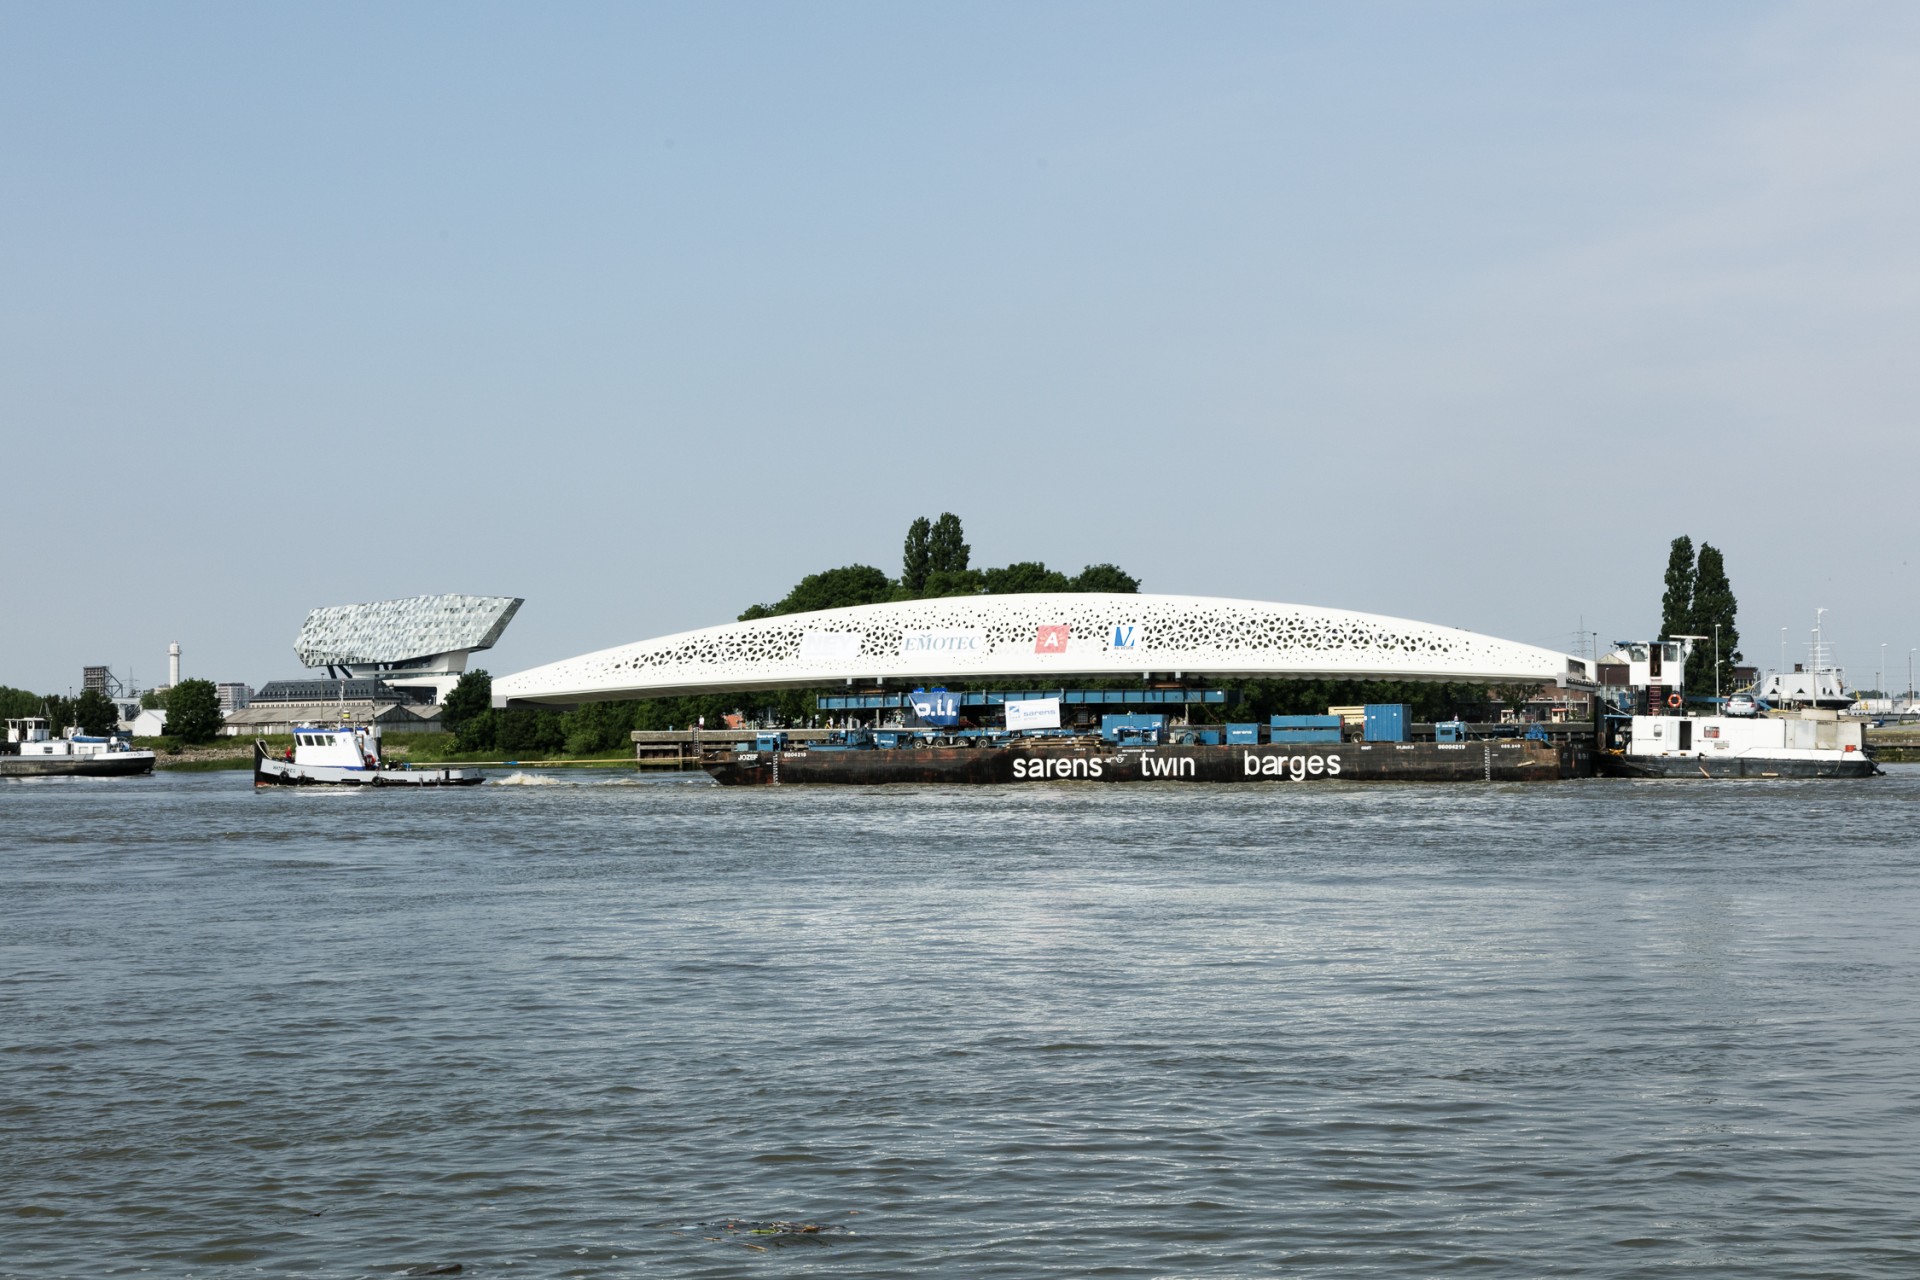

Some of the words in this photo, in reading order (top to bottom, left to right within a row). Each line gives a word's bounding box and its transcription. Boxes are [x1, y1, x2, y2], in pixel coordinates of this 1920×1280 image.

[1043, 631, 1059, 647] A
[1023, 709, 1056, 717] sarens
[1012, 757, 1103, 778] sarens
[1140, 751, 1196, 777] twin
[1243, 750, 1342, 782] barges
